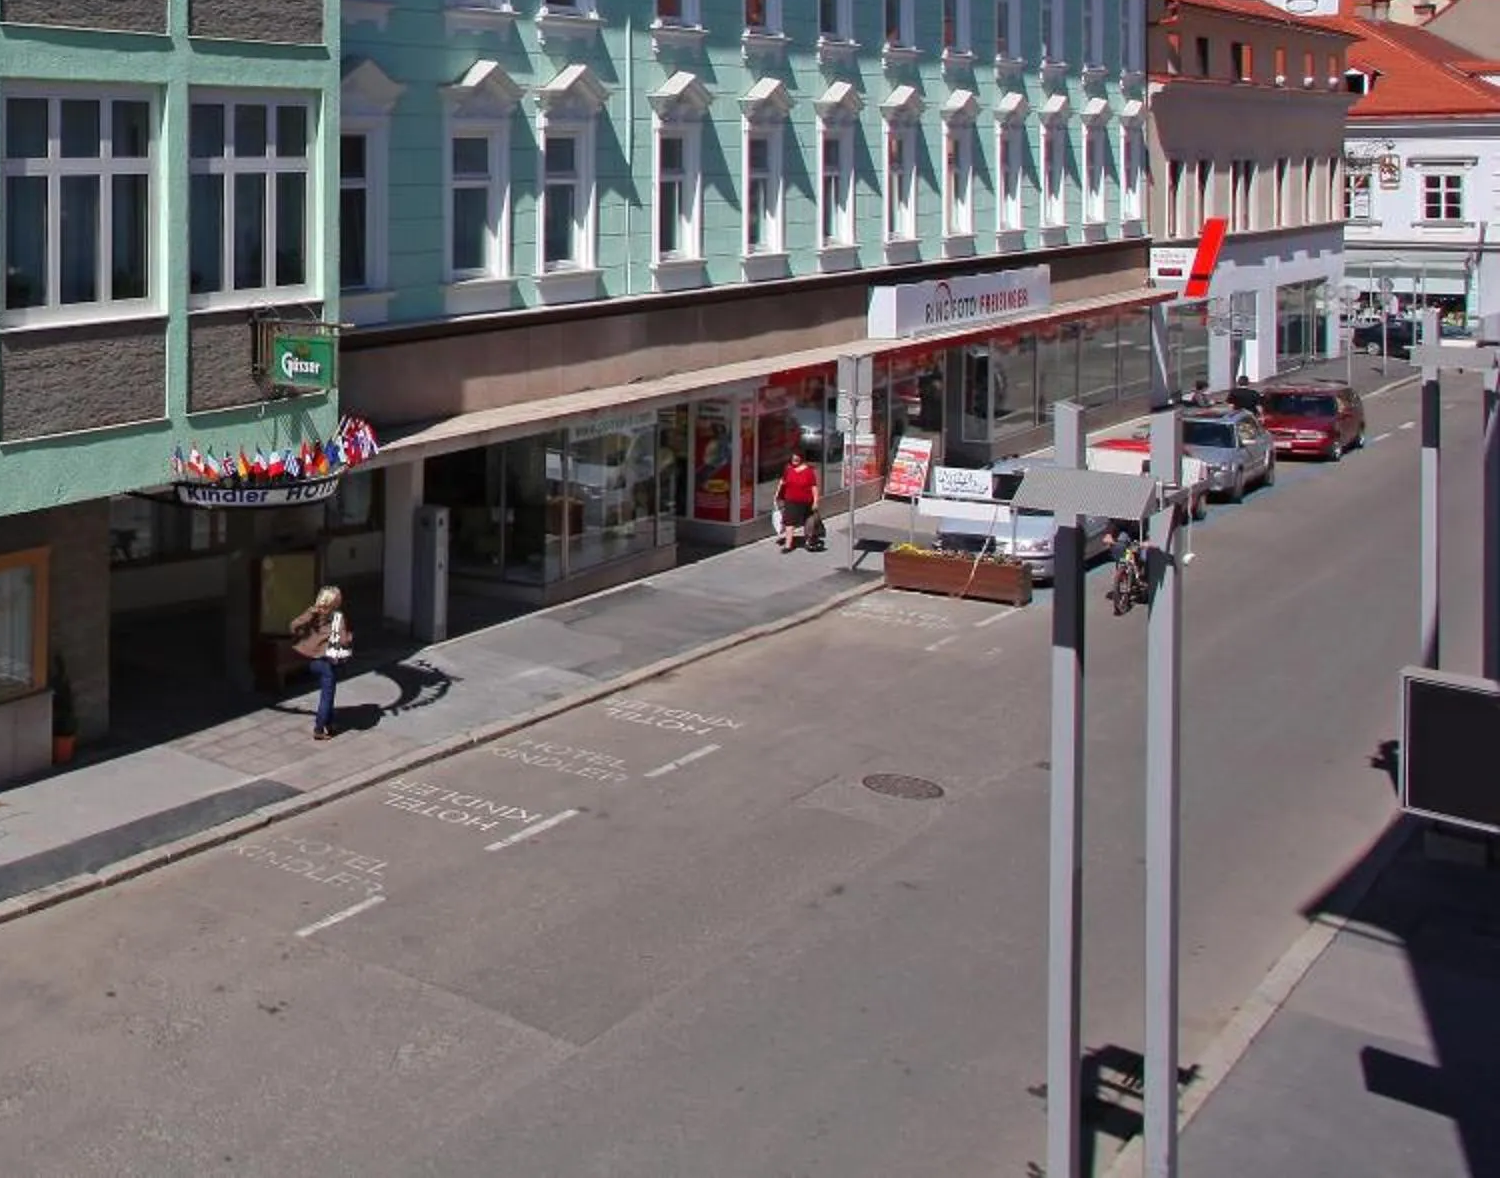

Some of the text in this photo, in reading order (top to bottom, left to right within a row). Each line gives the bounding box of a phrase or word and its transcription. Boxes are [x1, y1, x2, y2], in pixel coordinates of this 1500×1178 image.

[187, 483, 269, 503] Kindler
[382, 791, 499, 832] HOTEL
[386, 777, 543, 824] KINDLER
